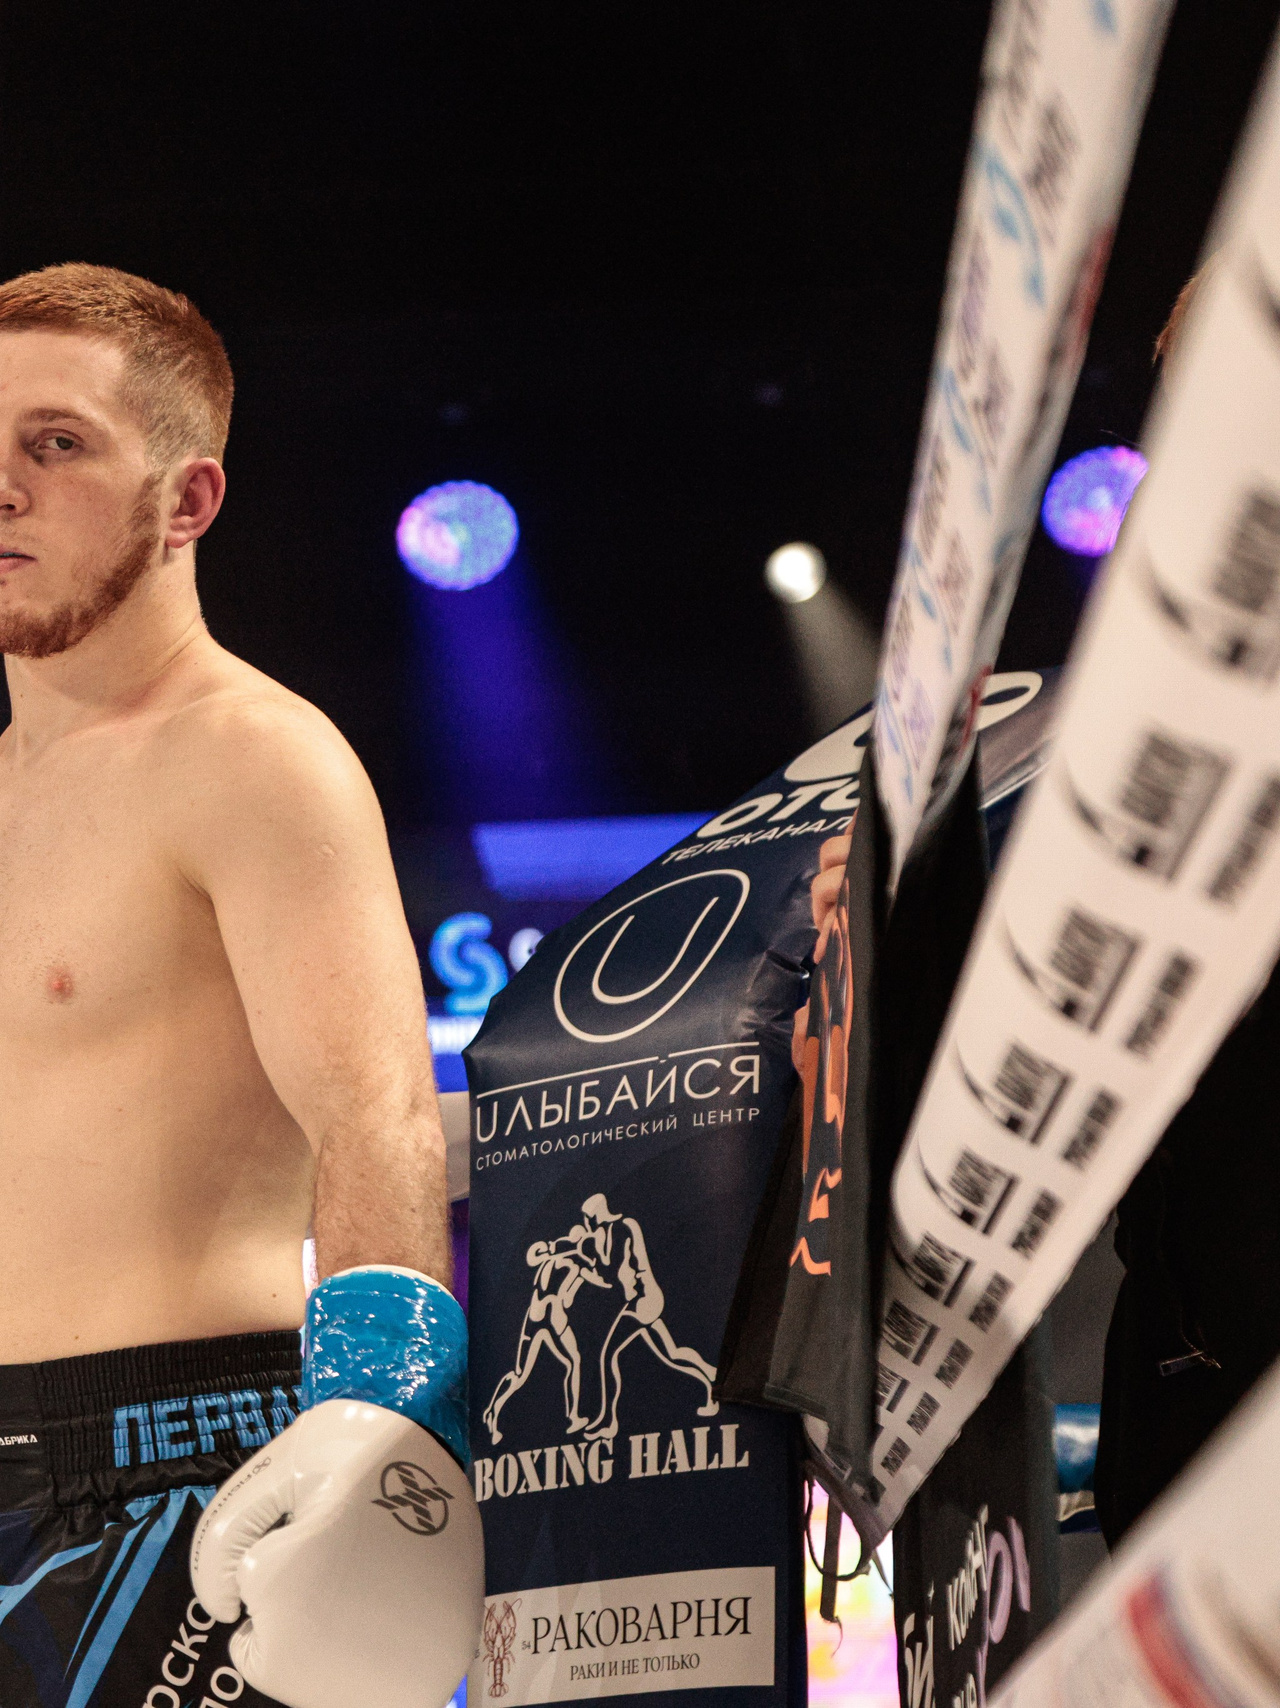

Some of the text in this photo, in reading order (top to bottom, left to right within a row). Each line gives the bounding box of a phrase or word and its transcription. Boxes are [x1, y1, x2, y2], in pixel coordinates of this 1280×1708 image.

[661, 816, 853, 866] ТЕЛЕКАНАЛ
[476, 1107, 760, 1171] СТОМАТОЛОГИЧЕСКИЙ ЦЕНТР
[474, 1424, 749, 1502] BOXING HALL
[531, 1596, 752, 1655] РАКОВАРНЯ
[570, 1653, 700, 1681] РАКИ И НЕ ТОЛЬКО
